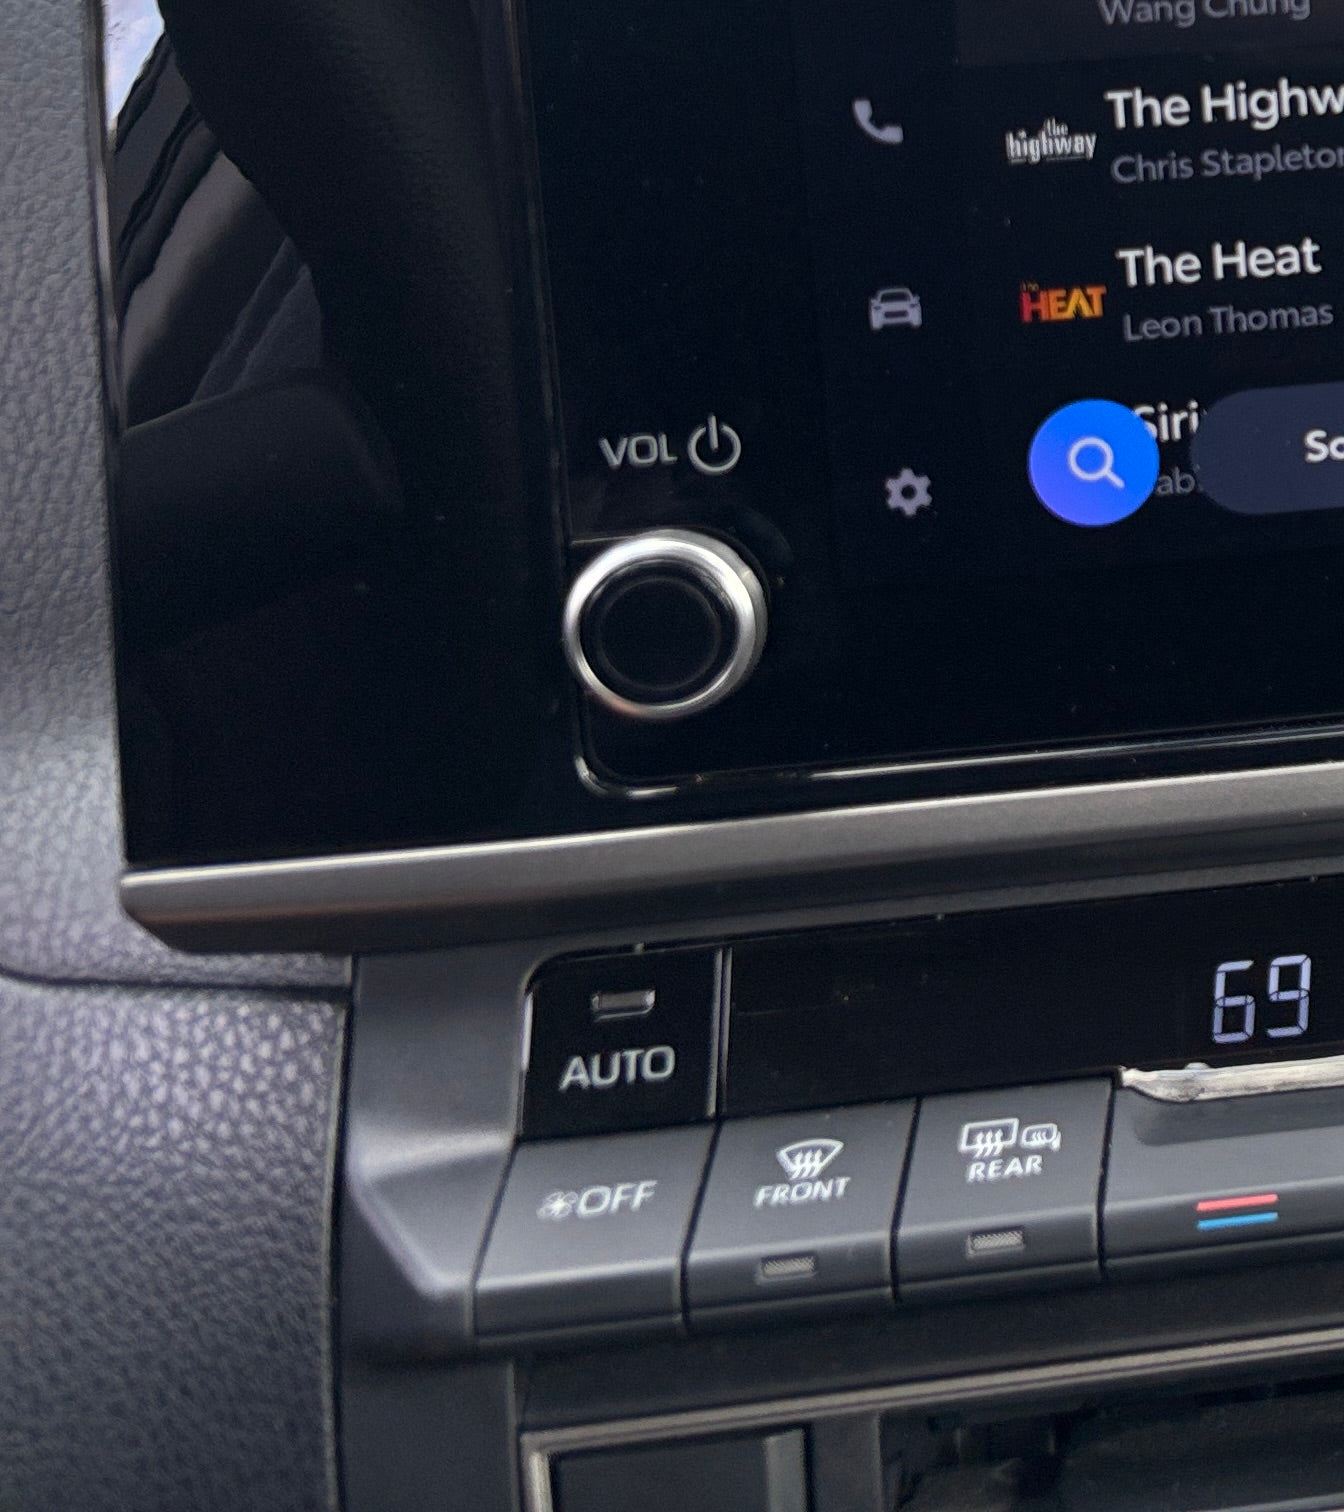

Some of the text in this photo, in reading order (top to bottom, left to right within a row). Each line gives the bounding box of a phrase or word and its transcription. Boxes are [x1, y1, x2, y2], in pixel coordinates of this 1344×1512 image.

[1104, 87, 1191, 129] The
[1110, 151, 1194, 184] Chris
[1116, 237, 1322, 287] The Heat
[1021, 285, 1107, 323] HEAT
[1123, 304, 1334, 342] Leon Thomas
[599, 433, 678, 468] VOL
[1211, 953, 1312, 1045] 69
[558, 1045, 676, 1091] AUTO
[967, 1151, 1043, 1183] REAR
[575, 1180, 658, 1219] OFF
[753, 1175, 851, 1208] FRONT
